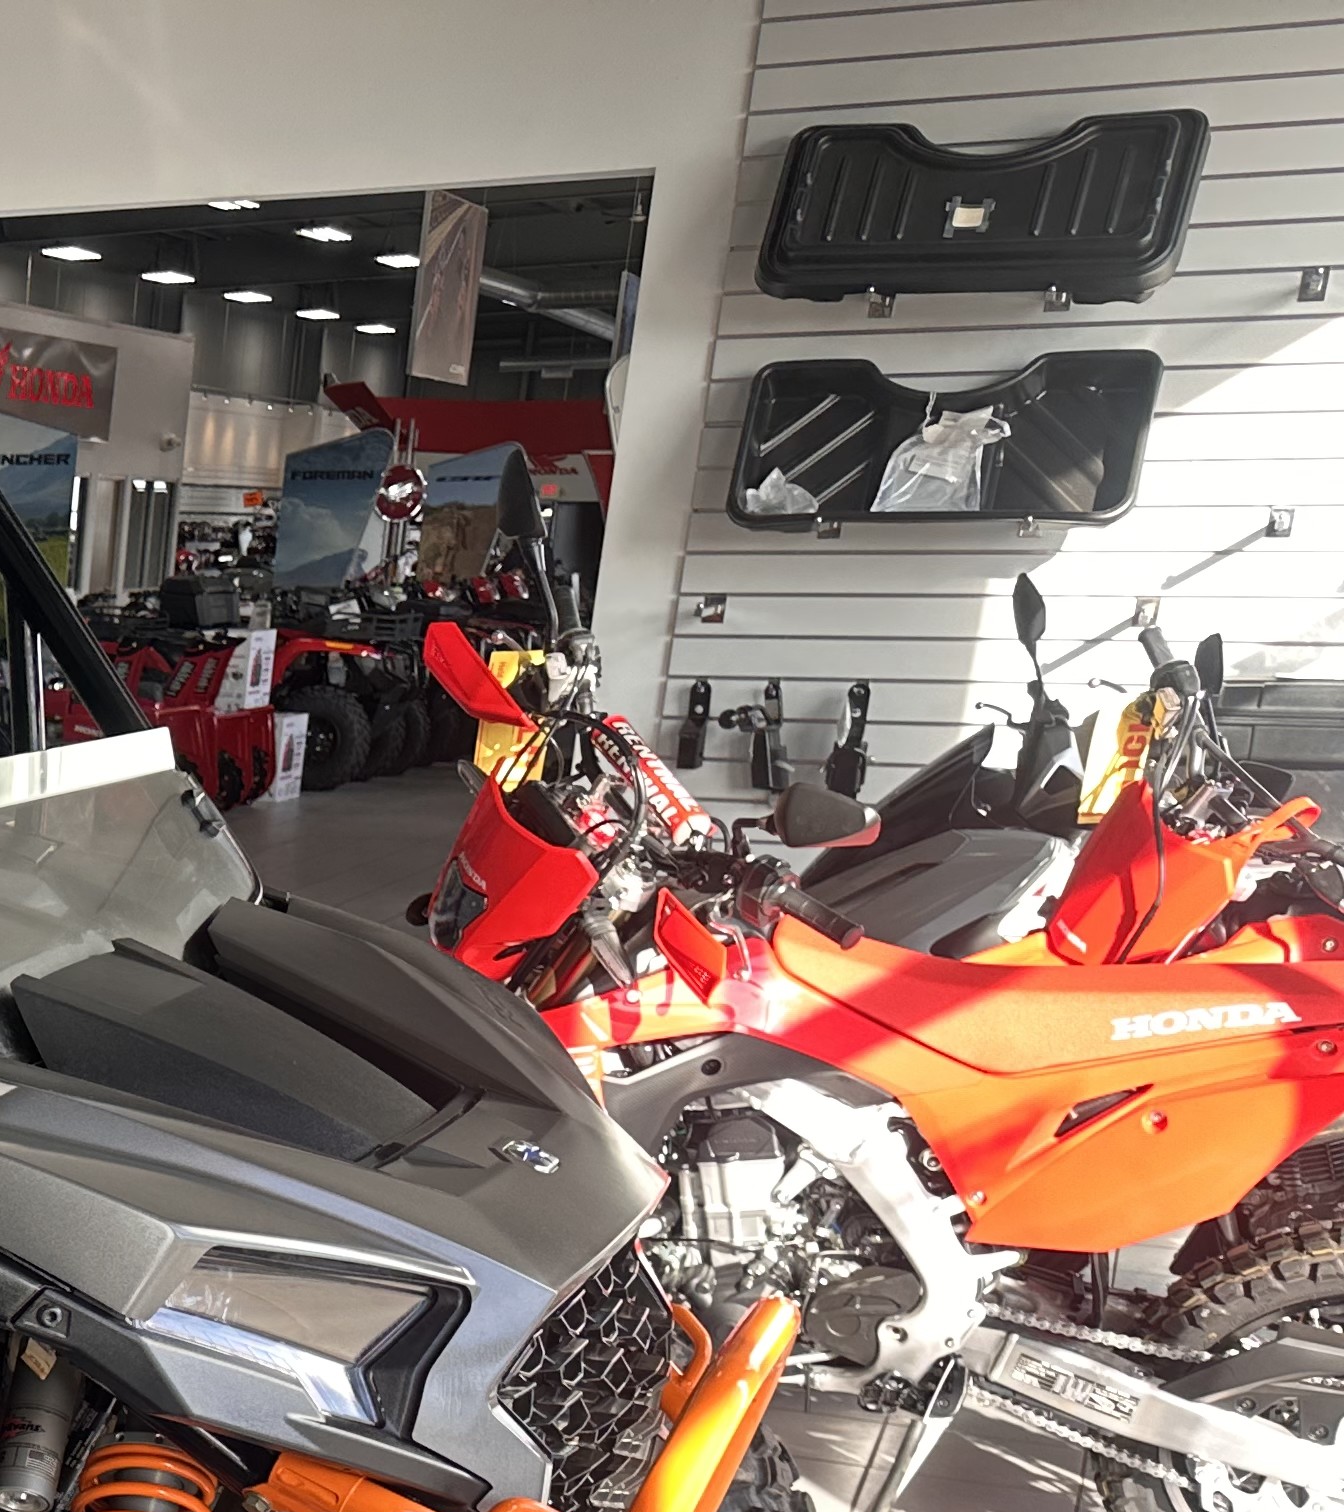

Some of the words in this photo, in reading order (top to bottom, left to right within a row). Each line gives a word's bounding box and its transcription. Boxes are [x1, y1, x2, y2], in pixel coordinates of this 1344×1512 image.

[8, 363, 95, 409] HONDA
[290, 468, 374, 481] FOREMAN
[596, 733, 680, 827] RENHAL
[1109, 1001, 1303, 1042] HONDA
